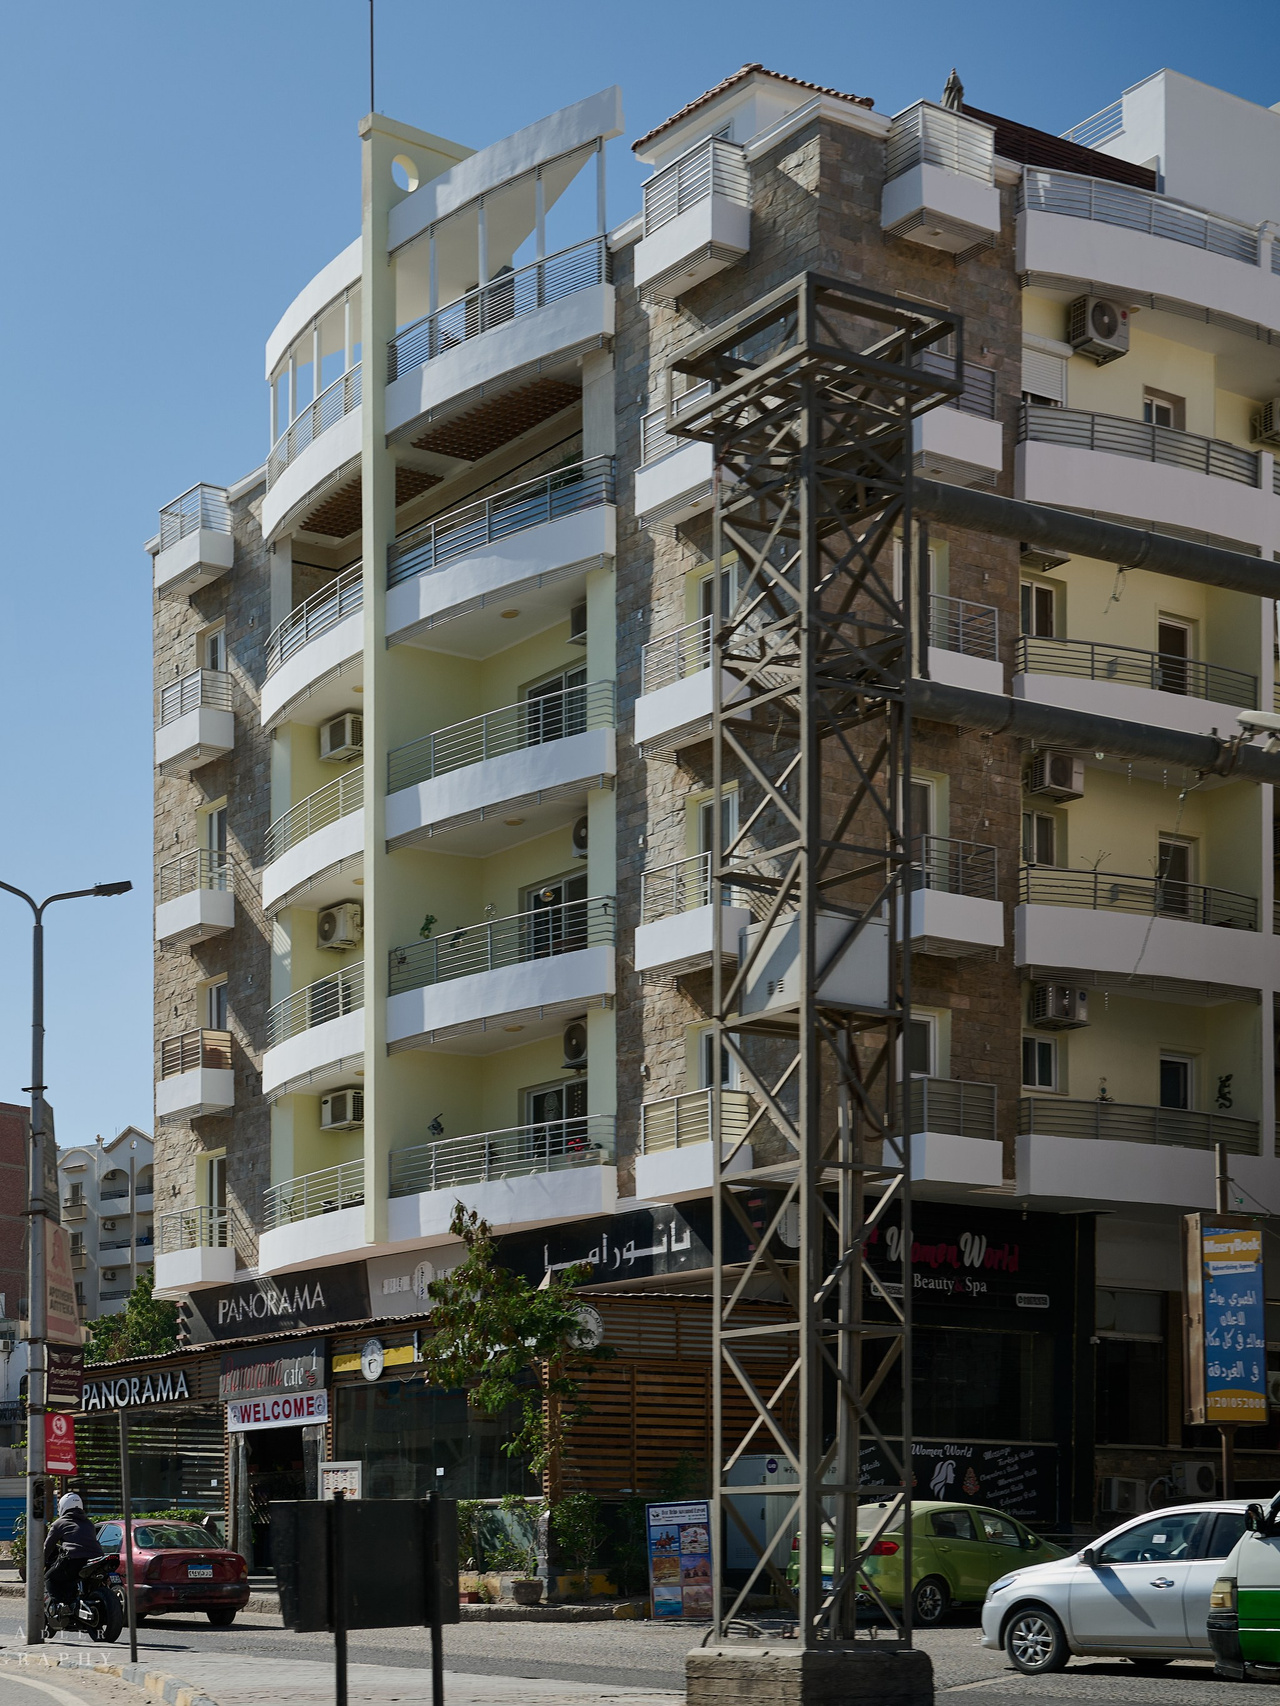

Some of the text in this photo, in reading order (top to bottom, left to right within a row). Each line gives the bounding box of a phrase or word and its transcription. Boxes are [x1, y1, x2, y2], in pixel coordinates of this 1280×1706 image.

[543, 1220, 692, 1273] بانوراما
[959, 1231, 1020, 1273] World
[912, 1273, 954, 1296] Beauty
[965, 1276, 988, 1297] Spa
[217, 1282, 327, 1325] PANORAMA
[49, 1366, 82, 1377] Angelina
[81, 1370, 191, 1412] PANORAMA
[239, 1395, 316, 1424] WELCOME
[910, 1443, 974, 1458] Women World
